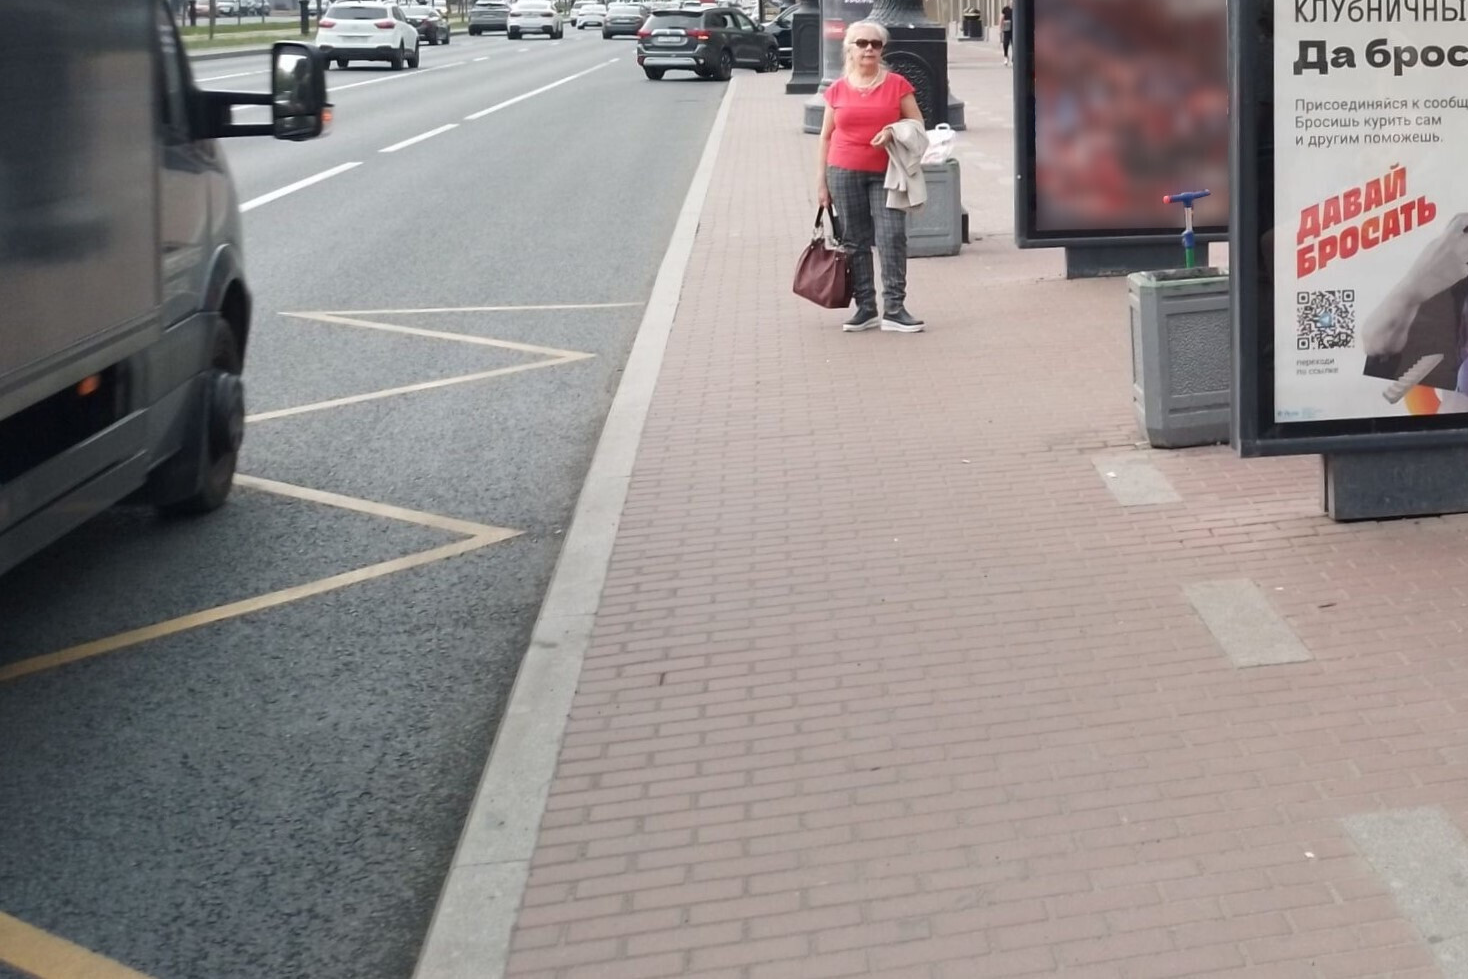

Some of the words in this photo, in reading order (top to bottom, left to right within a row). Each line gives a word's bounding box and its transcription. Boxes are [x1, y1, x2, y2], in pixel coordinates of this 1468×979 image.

[1293, 40, 1356, 76] Да
[1295, 97, 1408, 112] Присоединяйся
[1412, 99, 1420, 109] к
[1295, 115, 1360, 129] Бросишь
[1364, 116, 1412, 129] курить
[1415, 116, 1442, 127] сам
[1295, 135, 1304, 145] и
[1308, 133, 1360, 148] другим
[1364, 133, 1443, 145] поможешь.
[1297, 163, 1408, 245] ДАВАЙ
[1297, 196, 1437, 279] БРОСАТЬ
